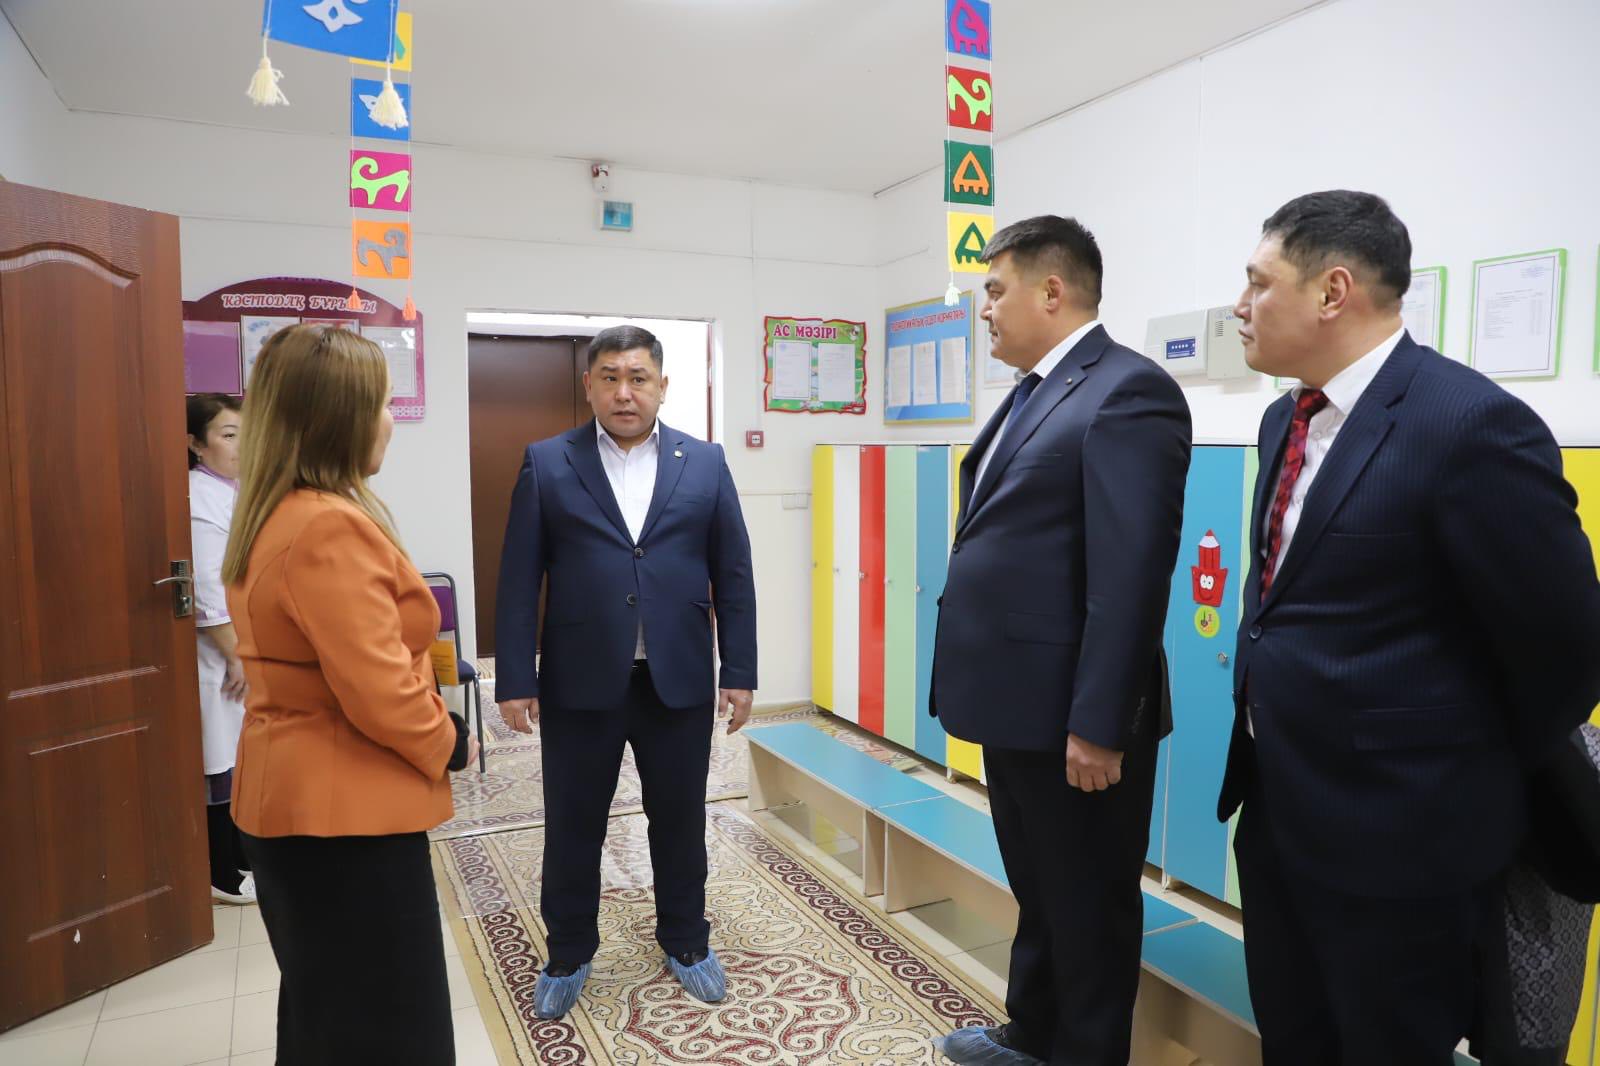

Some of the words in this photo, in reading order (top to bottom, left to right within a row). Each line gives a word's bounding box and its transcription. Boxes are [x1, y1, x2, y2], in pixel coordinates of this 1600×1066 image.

[309, 296, 376, 313] БҰРЫЫ
[773, 323, 791, 337] АС
[795, 325, 837, 339] МӘЗІРІ
